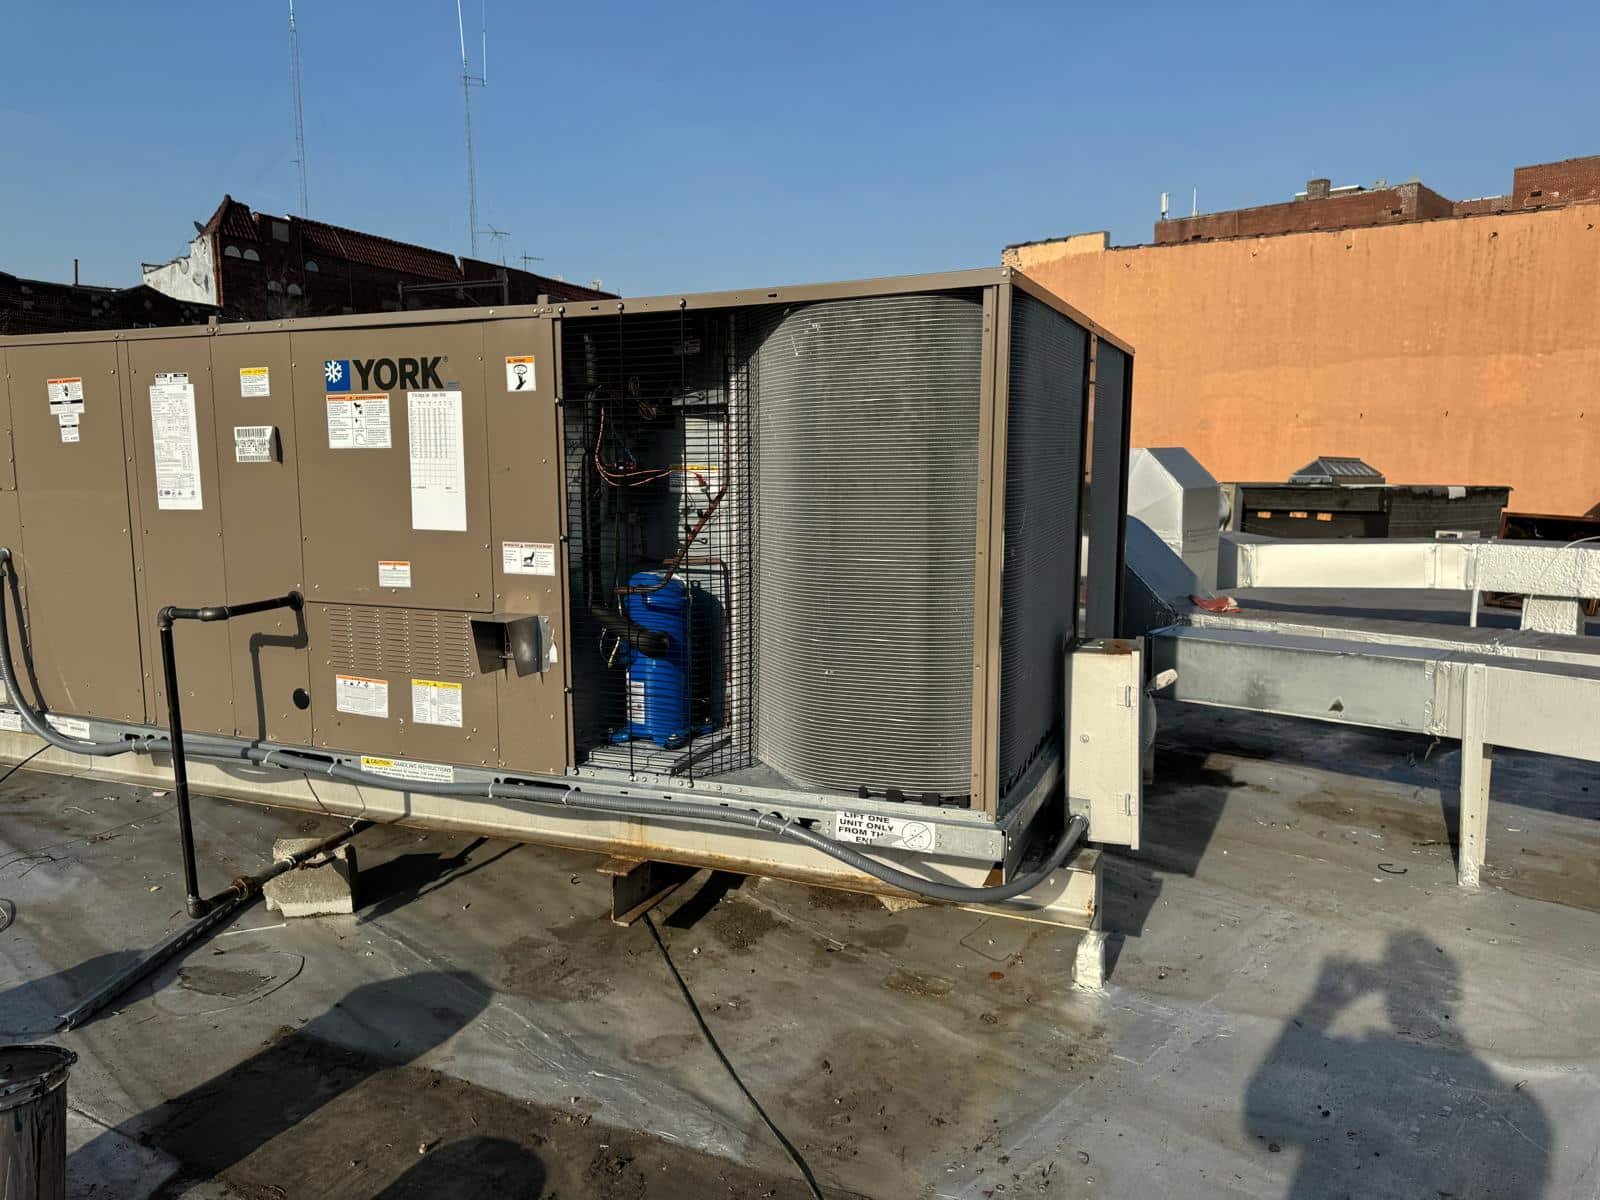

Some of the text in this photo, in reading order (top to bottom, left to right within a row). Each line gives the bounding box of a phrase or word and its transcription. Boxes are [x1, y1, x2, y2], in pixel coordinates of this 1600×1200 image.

[352, 356, 444, 391] YORK
[839, 818, 894, 832] UNIT ONLY
[868, 815, 889, 824] ONE
[838, 826, 867, 836] FROM
